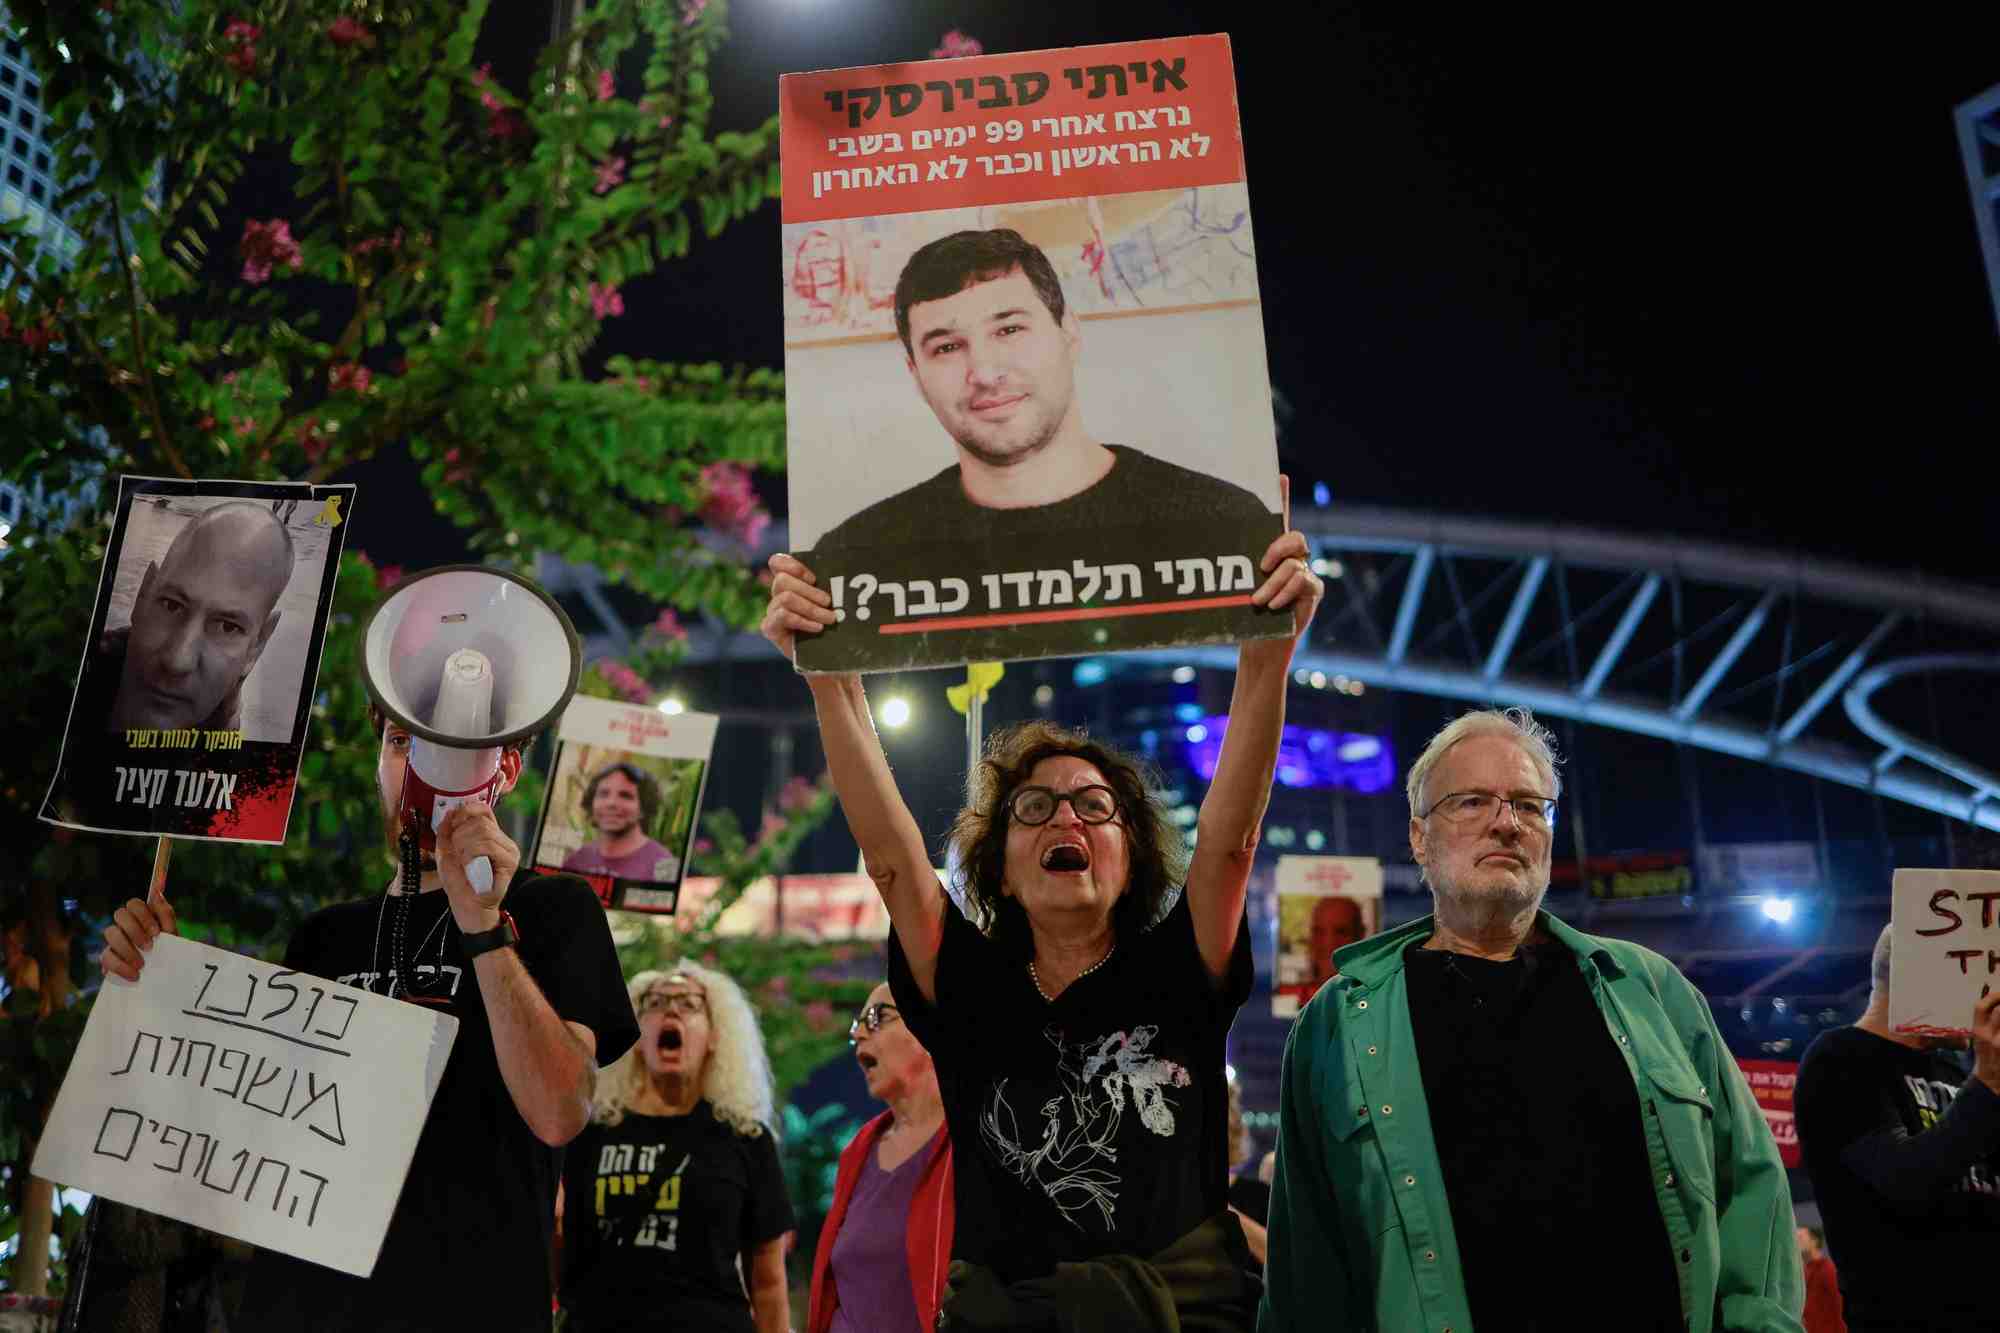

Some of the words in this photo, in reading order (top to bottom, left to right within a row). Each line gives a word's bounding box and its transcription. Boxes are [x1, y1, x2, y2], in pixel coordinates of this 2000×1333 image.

[1064, 58, 1187, 98] איתי
[823, 72, 1049, 128] סבירסקי
[985, 120, 1023, 143] 99
[1032, 114, 1106, 137] אחרי
[1115, 106, 1190, 131] נרצח
[829, 133, 903, 156] בשבי
[912, 126, 976, 150] ימים
[1170, 133, 1210, 158] לא
[927, 155, 968, 181] לא
[976, 152, 1042, 175] וכבר
[1051, 142, 1160, 176] הראשון
[813, 164, 918, 197] האחרון
[983, 561, 1141, 608] תלמדו
[1155, 556, 1254, 594] מתי
[126, 729, 159, 748] בשבי
[160, 728, 199, 748] למוות
[204, 729, 242, 752] הופקר
[115, 766, 169, 809] קציר
[174, 769, 238, 810] אלעד
[195, 963, 358, 1040] כולנו
[110, 1031, 345, 1146] משפחות
[93, 1107, 328, 1224] החטופים
